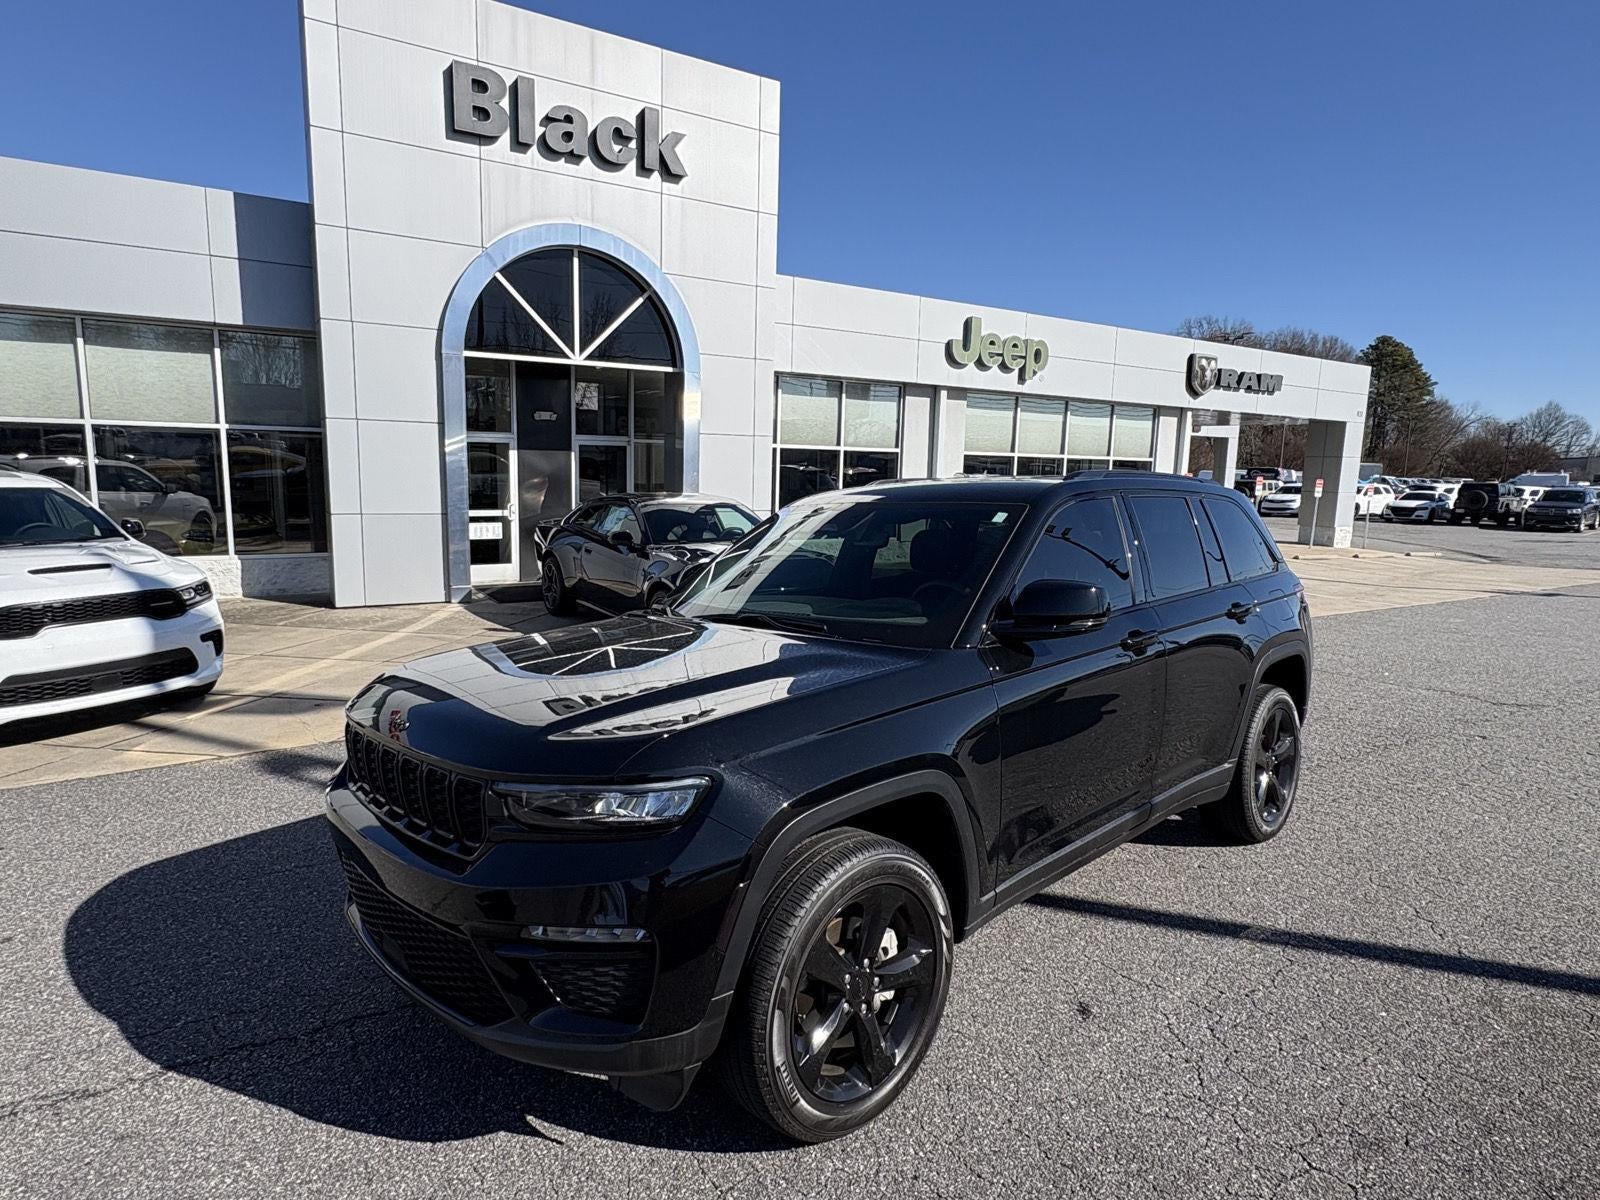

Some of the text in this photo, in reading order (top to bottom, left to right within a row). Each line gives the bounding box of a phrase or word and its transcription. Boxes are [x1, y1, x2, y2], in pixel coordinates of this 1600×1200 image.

[443, 59, 687, 184] Black
[946, 316, 1049, 384] Jeep
[1217, 368, 1283, 394] RAM
